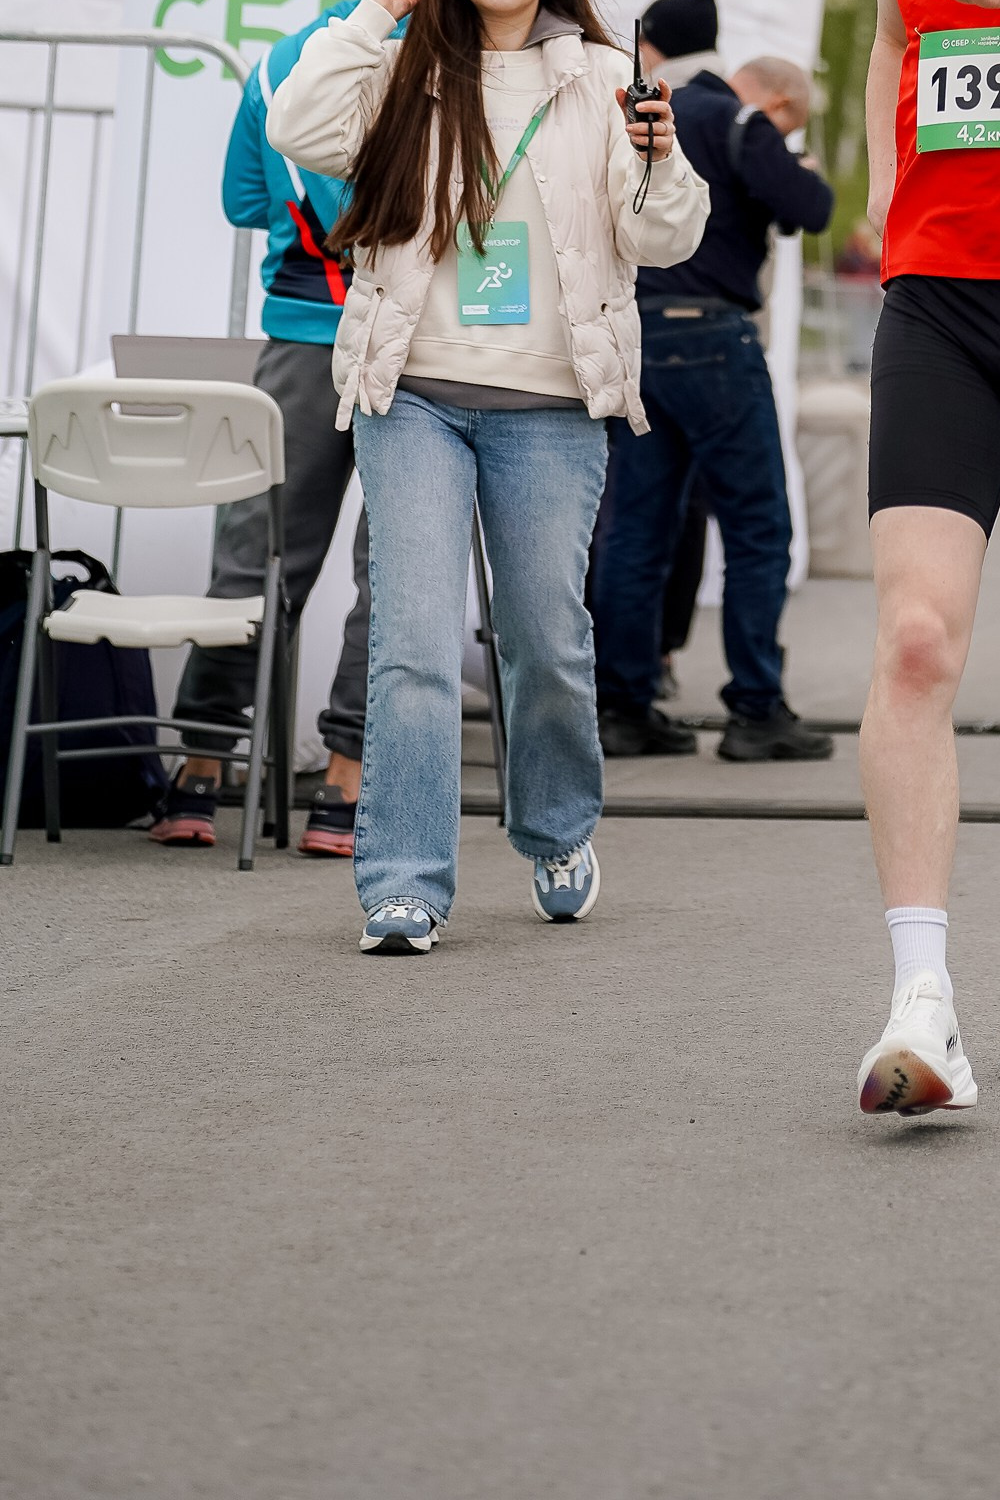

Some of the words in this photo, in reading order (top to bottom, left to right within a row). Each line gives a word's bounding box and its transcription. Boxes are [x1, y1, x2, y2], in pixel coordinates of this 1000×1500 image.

[950, 39, 970, 47] СБЕР
[956, 123, 985, 145] 4,2
[467, 239, 520, 247] ОАНИЗАТОР
